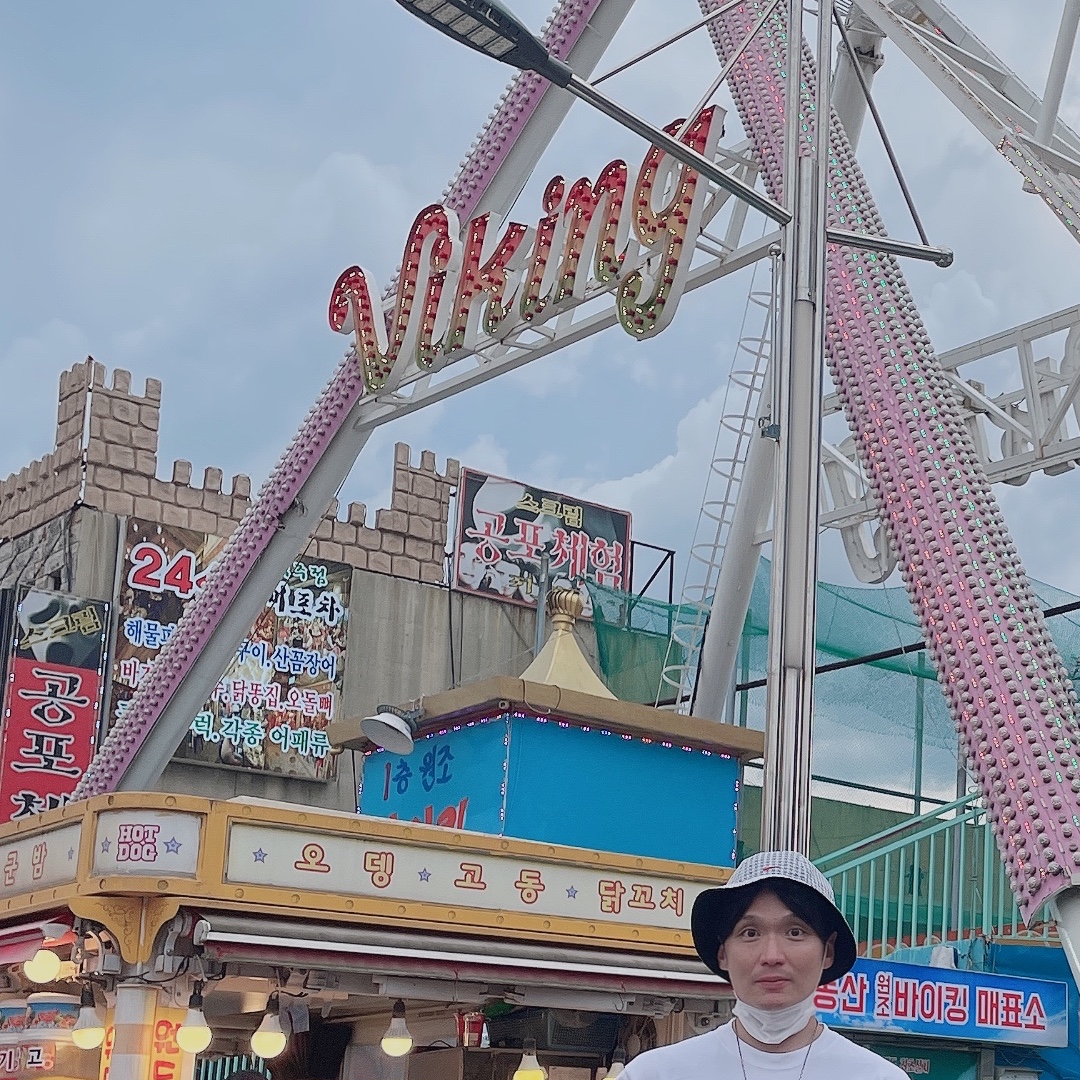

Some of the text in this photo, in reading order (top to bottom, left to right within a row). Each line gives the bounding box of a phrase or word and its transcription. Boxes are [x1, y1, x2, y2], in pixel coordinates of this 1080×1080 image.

[328, 105, 722, 394] Viking
[465, 507, 623, 590] 공포체험
[131, 546, 208, 595] 24
[271, 727, 330, 755] 어패류
[116, 842, 158, 862] DOG
[118, 824, 160, 843] HOT
[598, 879, 684, 917] 닭꼬치
[895, 979, 969, 1023] 바이킹
[978, 989, 1046, 1031] 매표소
